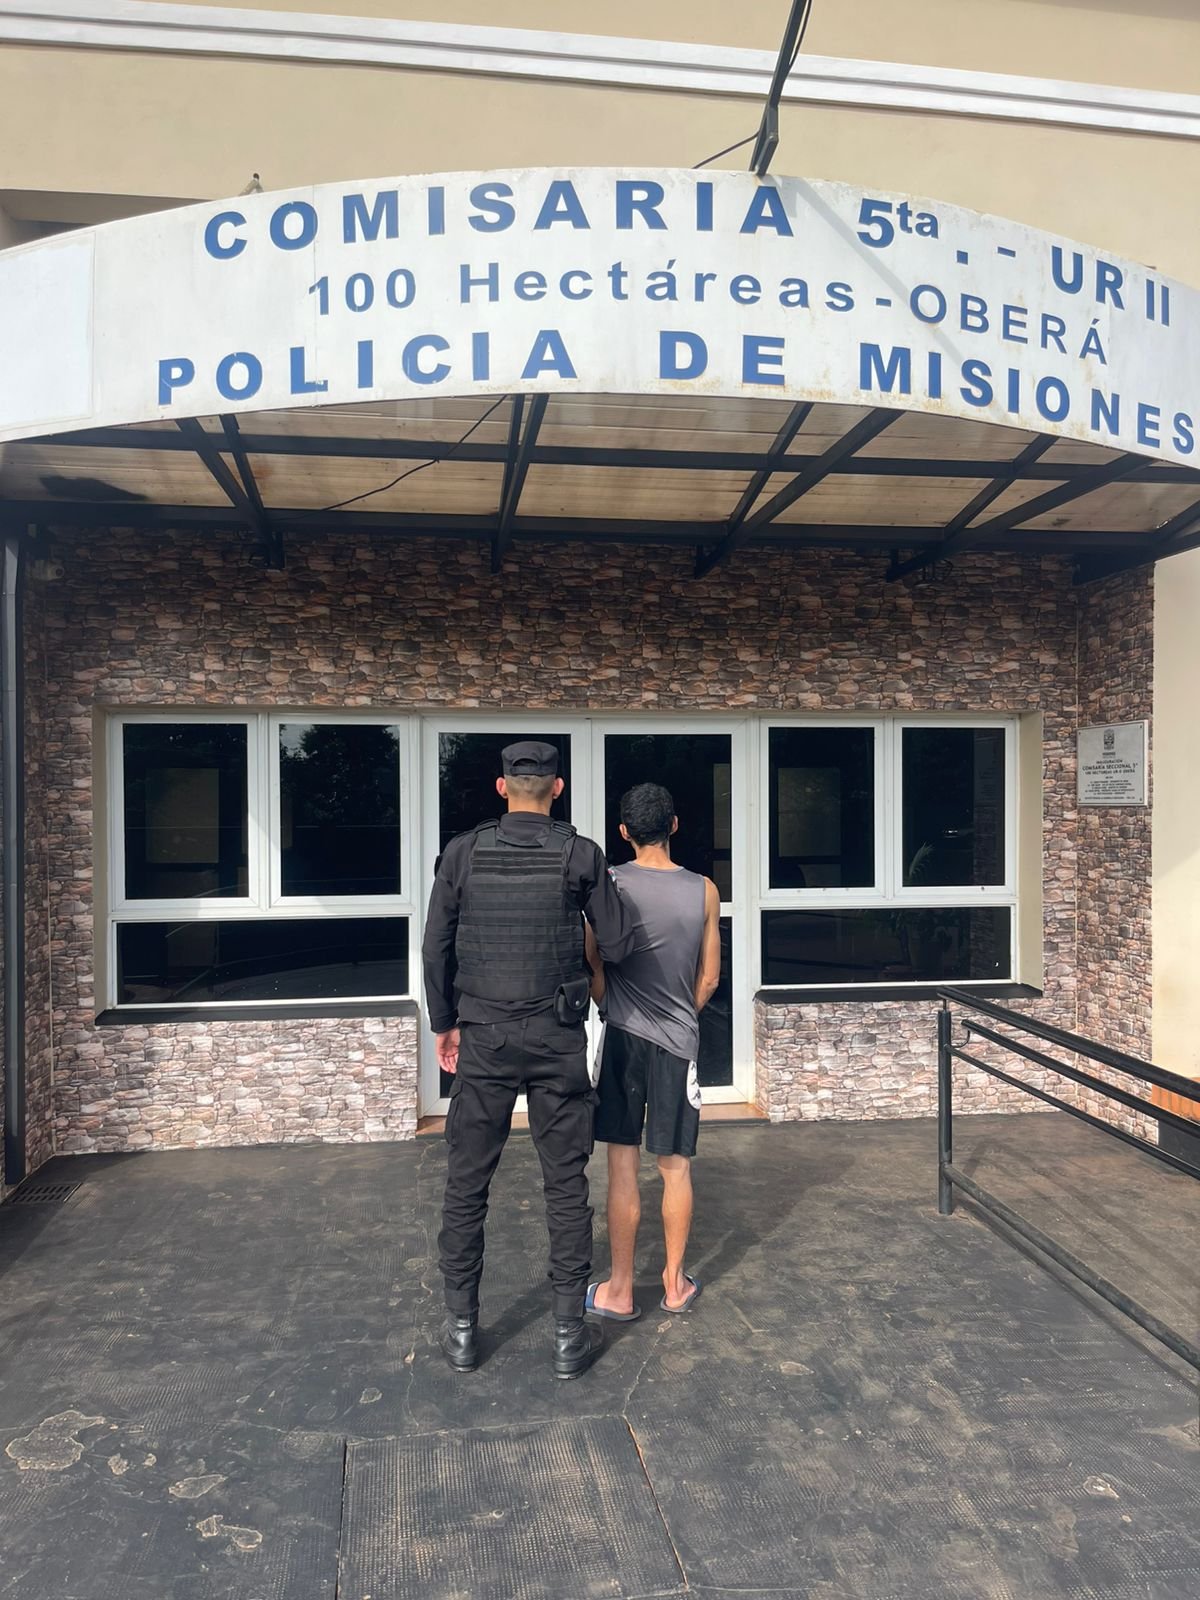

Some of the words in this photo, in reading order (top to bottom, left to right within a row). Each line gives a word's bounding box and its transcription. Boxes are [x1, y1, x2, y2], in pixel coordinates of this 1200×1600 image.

[203, 180, 793, 260] COMISARIA
[1051, 246, 1124, 310] UR
[308, 268, 416, 315] 100
[157, 329, 577, 406] POLICIA
[658, 330, 786, 386] DE
[859, 342, 1195, 455] MISIONES
